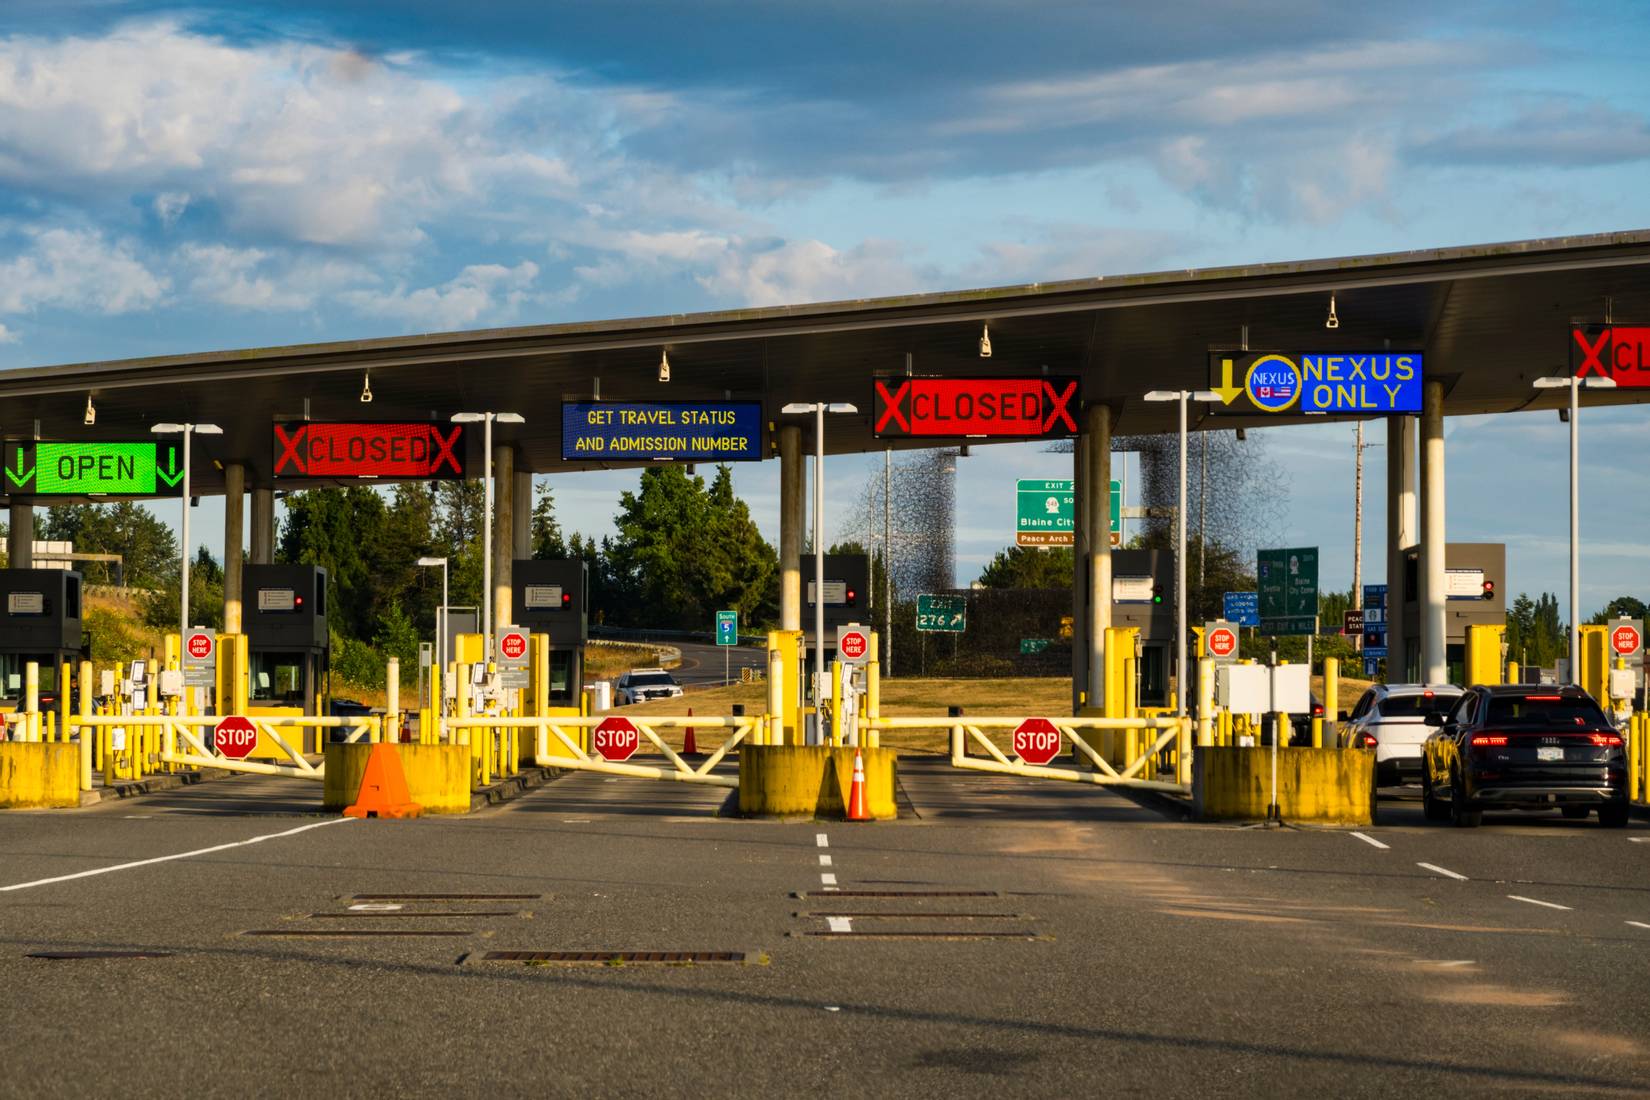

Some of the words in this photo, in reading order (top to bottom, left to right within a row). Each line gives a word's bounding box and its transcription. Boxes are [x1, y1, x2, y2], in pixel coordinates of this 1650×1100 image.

[1303, 356, 1414, 381] NEXUS
[1253, 372, 1295, 385] NEXUS
[1313, 384, 1402, 408] ONLY
[912, 392, 1041, 421] CLOSED
[587, 410, 614, 425] GET
[619, 410, 676, 425] TRAVEL
[681, 410, 736, 425] STATUS
[309, 436, 428, 463] CLOSED
[575, 437, 604, 451] AND
[609, 437, 687, 451] ADMISSION
[691, 437, 748, 451] NUMBER
[57, 455, 135, 480] OPEN
[1020, 518, 1053, 526] Blaine
[920, 614, 945, 626] 276
[724, 623, 730, 632] 5
[847, 637, 861, 645] STOP
[1215, 634, 1230, 642] STOP
[1618, 632, 1633, 640] STOP
[1618, 640, 1634, 648] HERE
[217, 729, 255, 745] STOP
[596, 730, 636, 747] STOP
[1016, 732, 1058, 750] STOP
